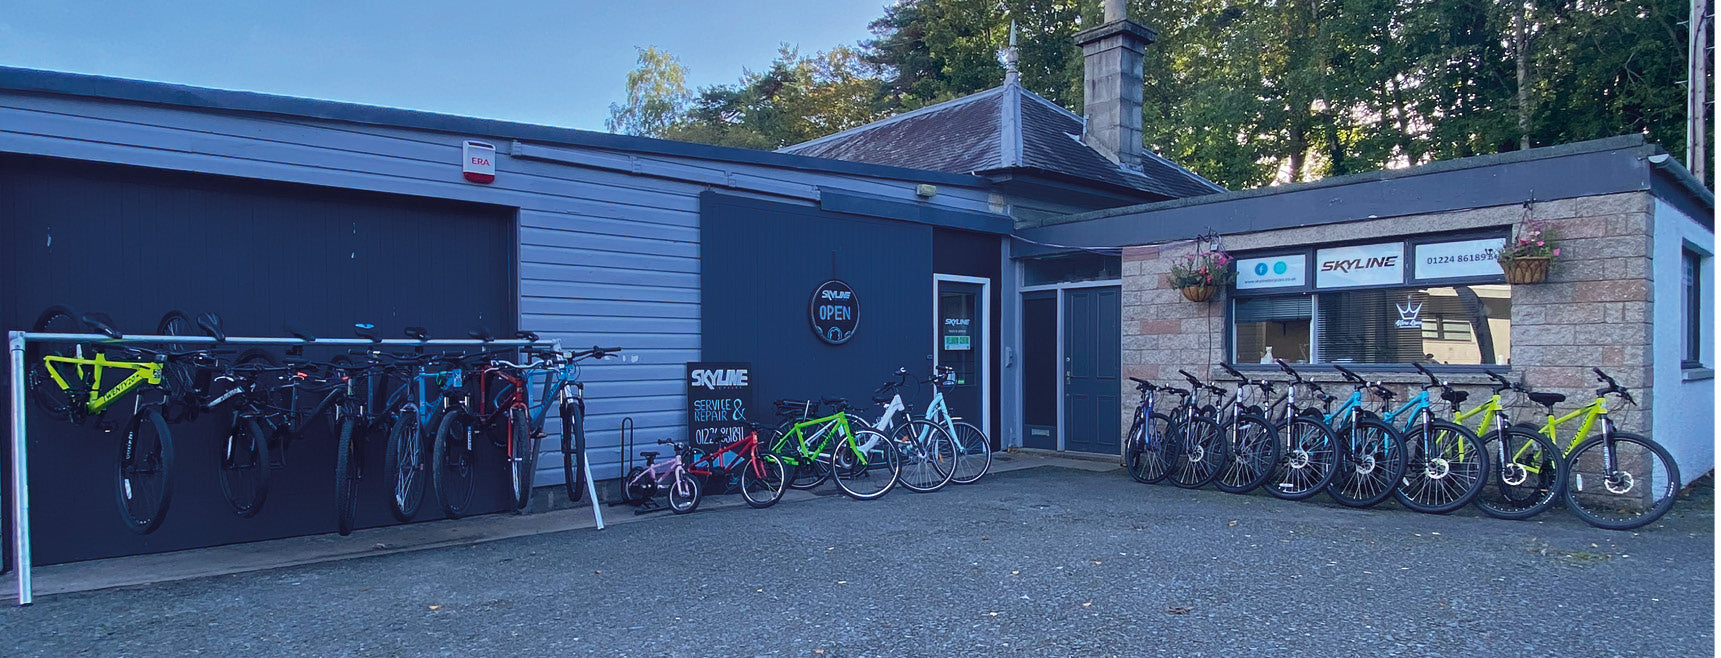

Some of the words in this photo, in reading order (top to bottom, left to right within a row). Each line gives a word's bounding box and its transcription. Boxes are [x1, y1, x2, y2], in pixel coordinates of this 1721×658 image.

[471, 157, 490, 166] ERA
[1321, 255, 1398, 273] SKYLINE
[1427, 256, 1455, 264] 01224
[821, 289, 851, 301] SKYLINE
[819, 304, 851, 320] OPEN
[944, 318, 970, 326] SKYLINE
[691, 369, 748, 390] SKYLINE
[693, 398, 732, 411] SERVICE
[732, 398, 747, 421] &
[694, 410, 728, 421] REPAIR
